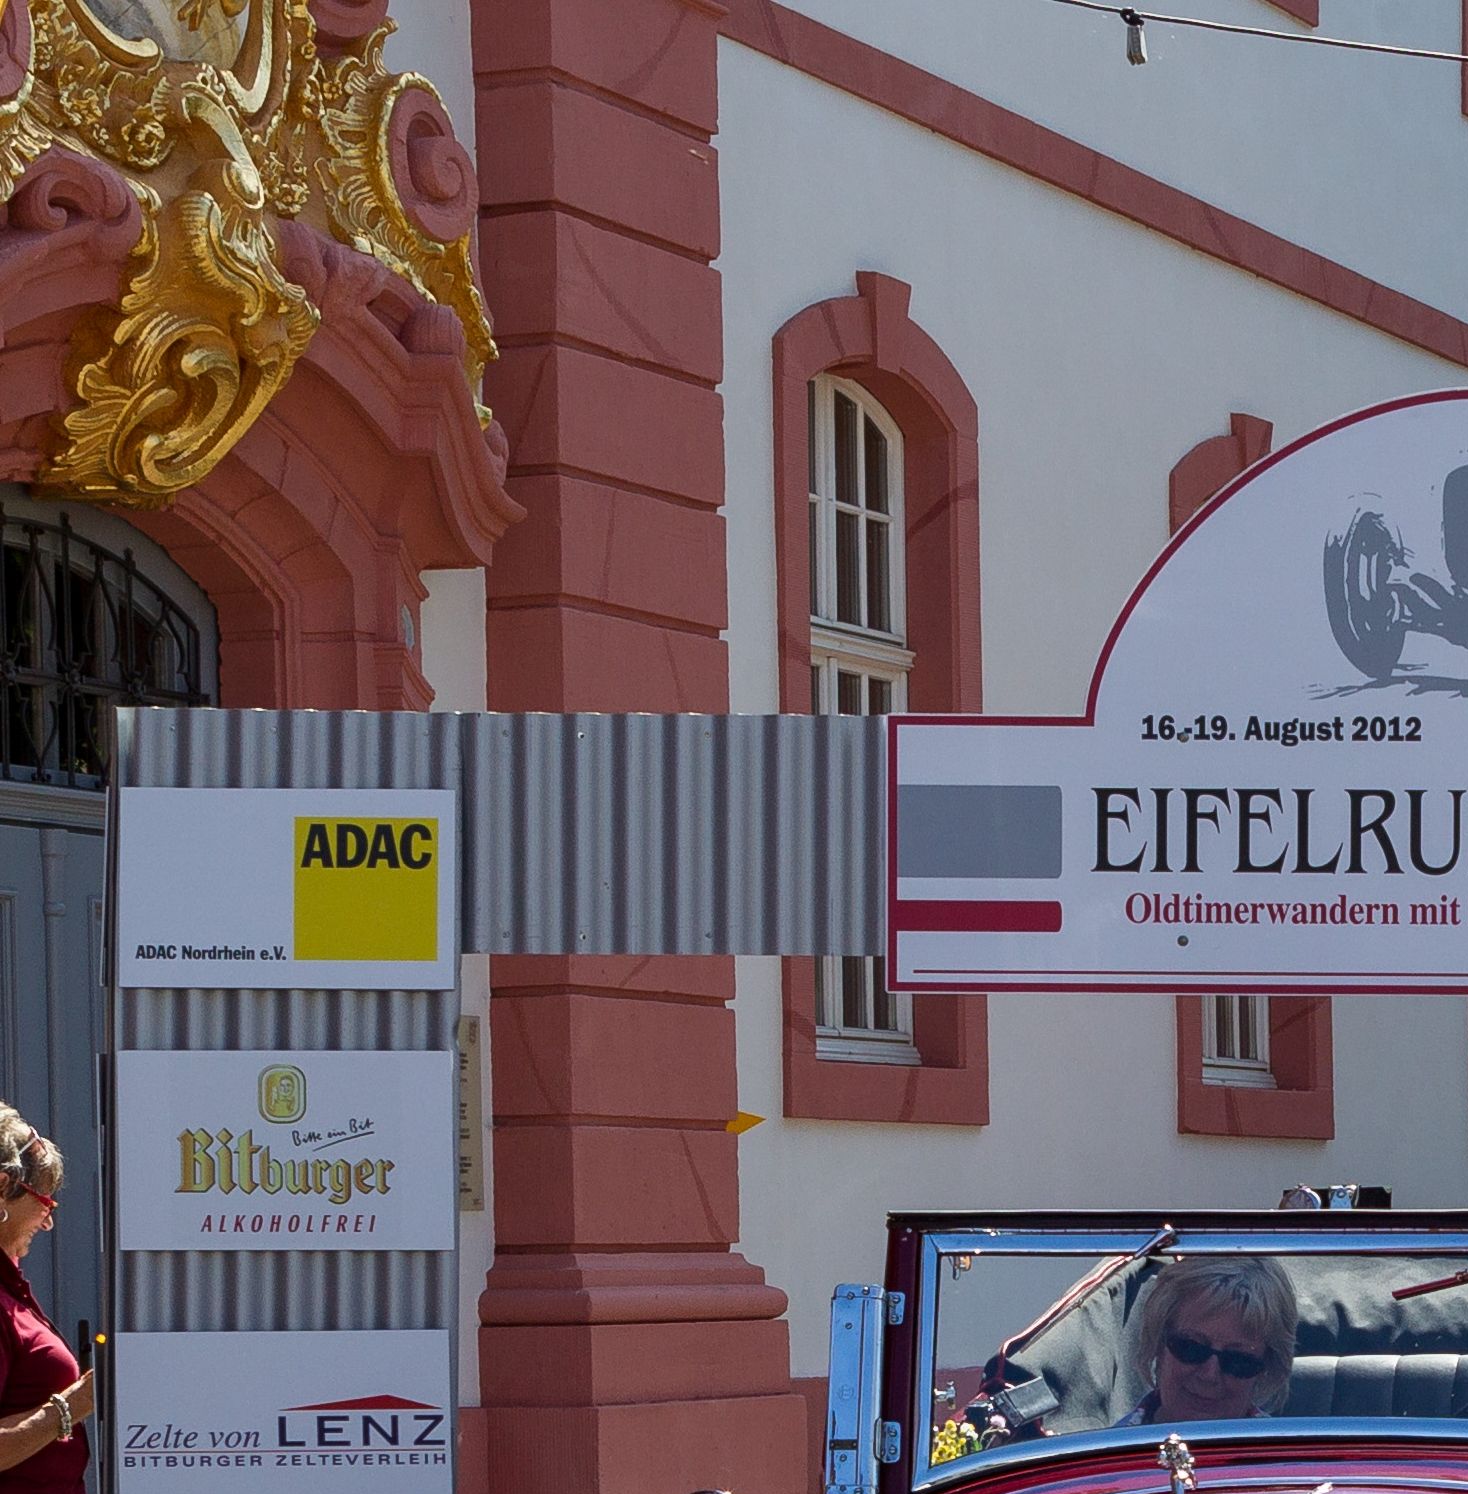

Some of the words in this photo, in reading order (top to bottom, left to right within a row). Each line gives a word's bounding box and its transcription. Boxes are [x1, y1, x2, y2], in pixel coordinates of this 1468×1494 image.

[1141, 715, 1236, 742] 16.-19.
[1244, 715, 1344, 747] August
[1351, 716, 1422, 742] 2012
[300, 823, 433, 869] ADAC
[1125, 892, 1400, 925] Oldtimerwandern
[1409, 895, 1461, 925] mit
[135, 944, 177, 960] ADAC
[181, 944, 255, 961] Nordrhein
[260, 946, 287, 960] e.V.
[292, 1130, 322, 1146] Bitte
[327, 1130, 346, 1139] ein
[349, 1118, 374, 1134] Bit
[174, 1127, 395, 1205] Bitburger
[201, 1214, 376, 1233] ALKOHOLFREI
[125, 1424, 198, 1449] Zelte
[209, 1432, 261, 1448] von
[278, 1415, 446, 1447] LENZ
[124, 1455, 263, 1468] BITBURGER
[276, 1453, 446, 1466] ZELTEVERLEIH
